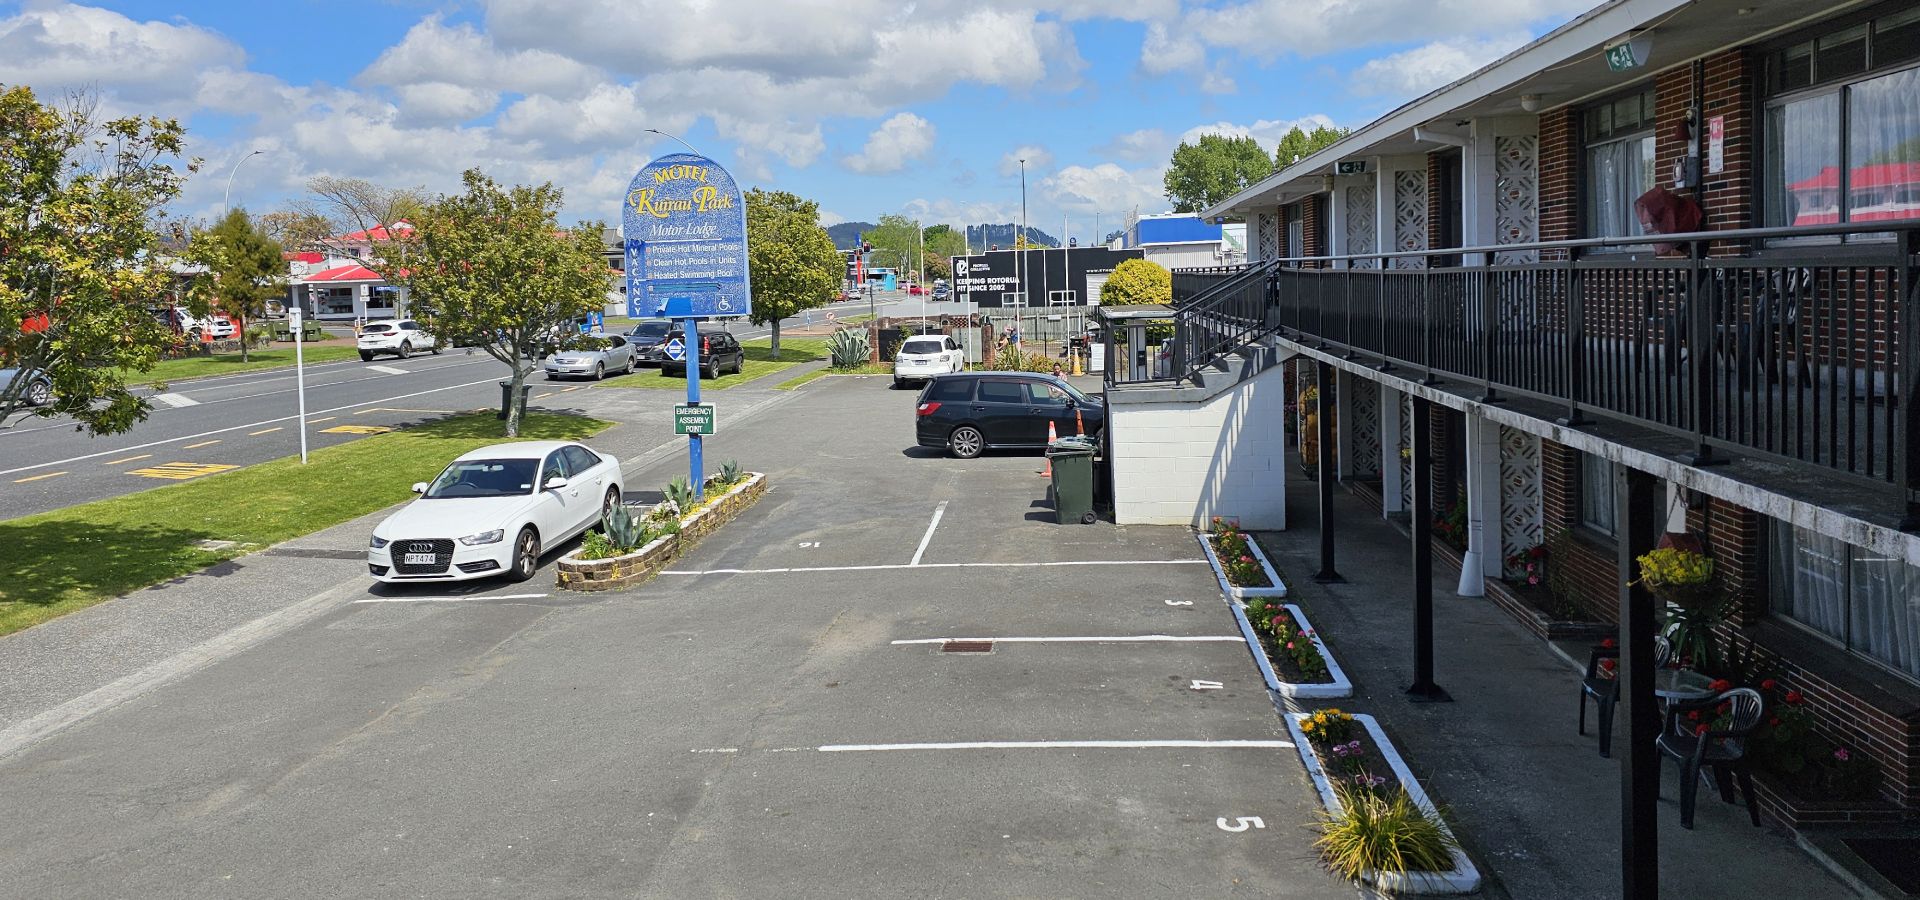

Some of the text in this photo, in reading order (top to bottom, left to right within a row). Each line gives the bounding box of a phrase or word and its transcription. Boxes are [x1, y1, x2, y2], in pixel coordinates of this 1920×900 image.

[654, 165, 709, 185] MOTEL
[628, 186, 734, 218] Kuirau Park
[649, 222, 717, 238] Motor Lodge
[652, 243, 738, 254] Private Hot Mineral Pools
[653, 256, 737, 267] Clean Hot Pools in Units
[654, 269, 733, 279] Heated Swimming Pool
[631, 248, 642, 316] VACANCY
[679, 416, 710, 424] ASSEMBLY
[685, 425, 703, 433] POINT
[405, 554, 433, 562] NPT474
[1189, 679, 1224, 690] 4
[1216, 816, 1266, 833] 5
